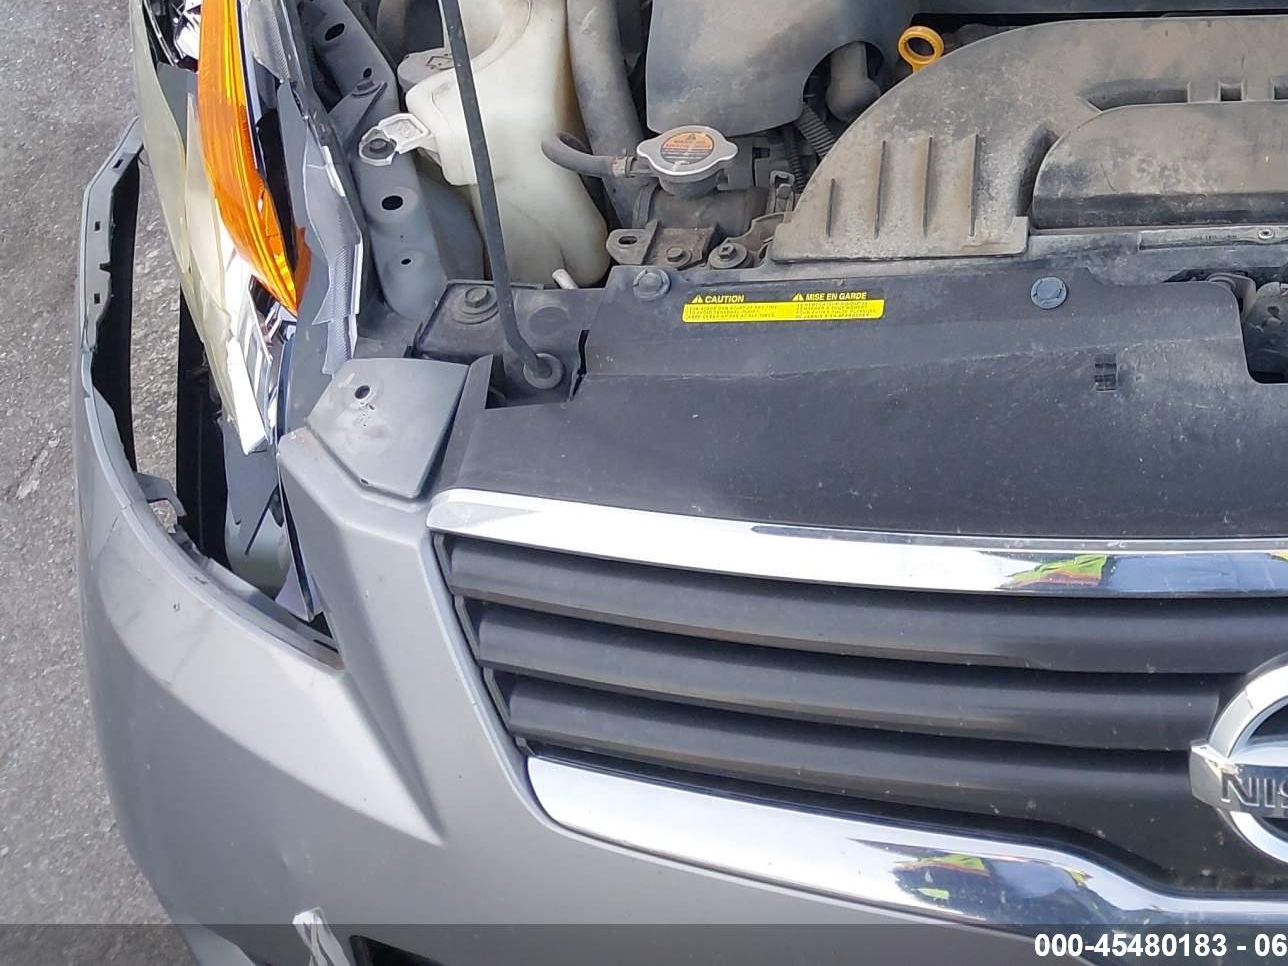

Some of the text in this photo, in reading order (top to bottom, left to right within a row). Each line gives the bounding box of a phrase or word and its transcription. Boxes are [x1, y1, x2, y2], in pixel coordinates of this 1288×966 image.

[704, 294, 745, 303] CAUTION
[805, 291, 867, 301] MISE EN GARDE
